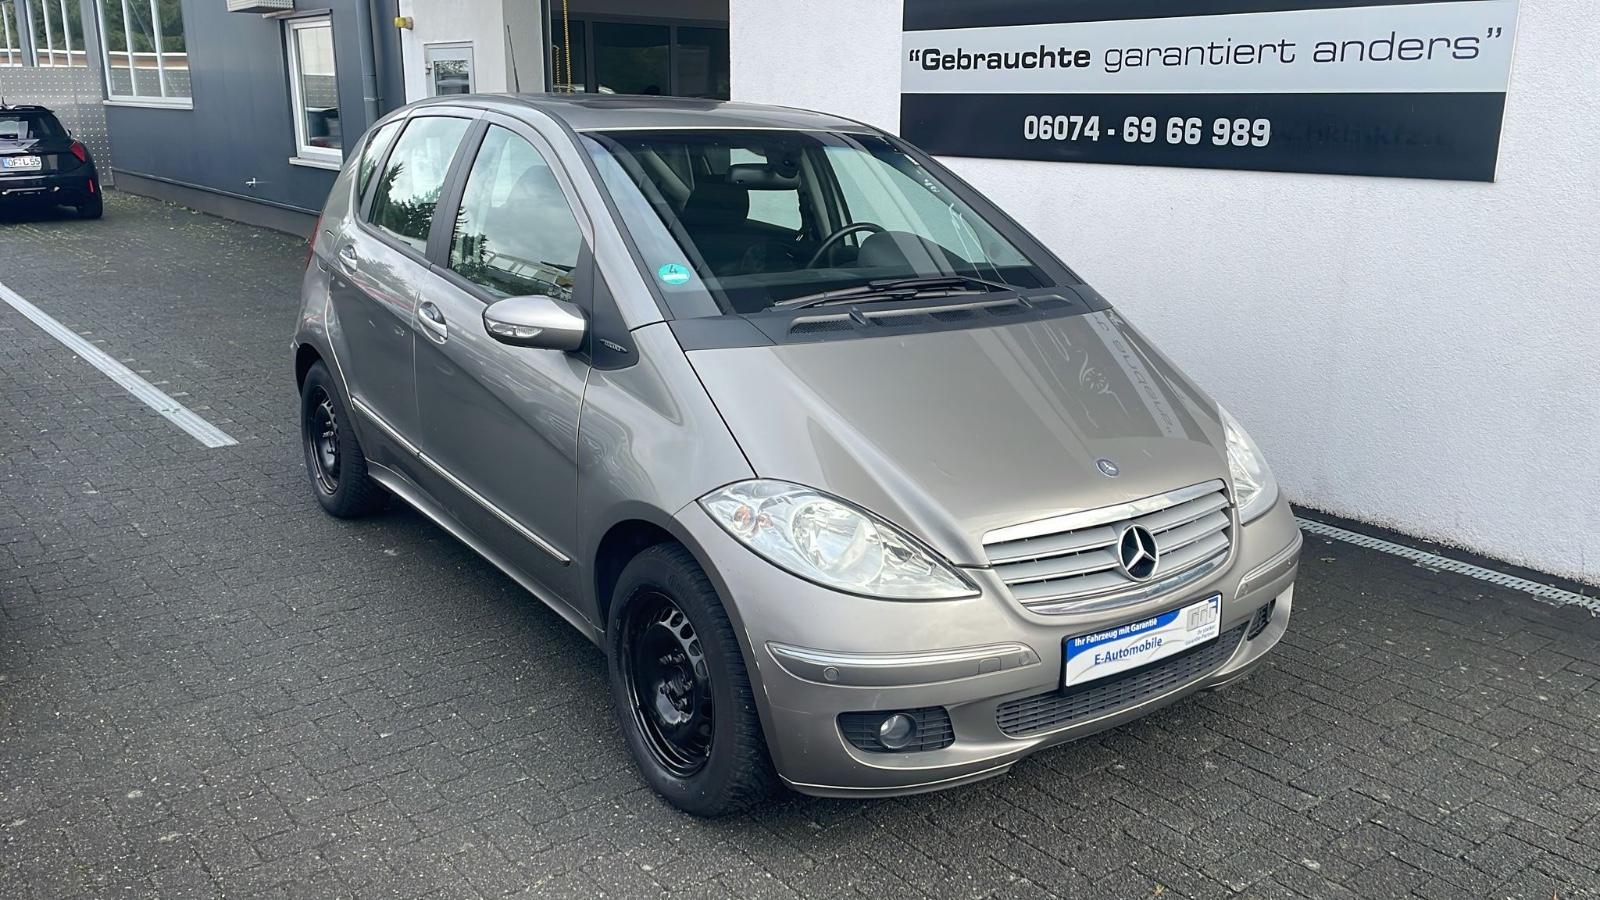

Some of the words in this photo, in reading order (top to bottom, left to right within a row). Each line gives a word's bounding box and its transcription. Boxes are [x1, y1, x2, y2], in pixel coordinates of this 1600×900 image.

[1104, 37, 1296, 73] garantiert
[1024, 115, 1099, 141] 06074
[1123, 116, 1157, 143] 69
[1166, 117, 1202, 145] 66
[1212, 118, 1271, 147] 989
[1074, 638, 1086, 647] Ihr
[1086, 629, 1118, 644] Fahrzeug
[1118, 625, 1130, 635] mit
[1130, 618, 1157, 632] Garantie
[1094, 637, 1163, 665] E-Automobile
